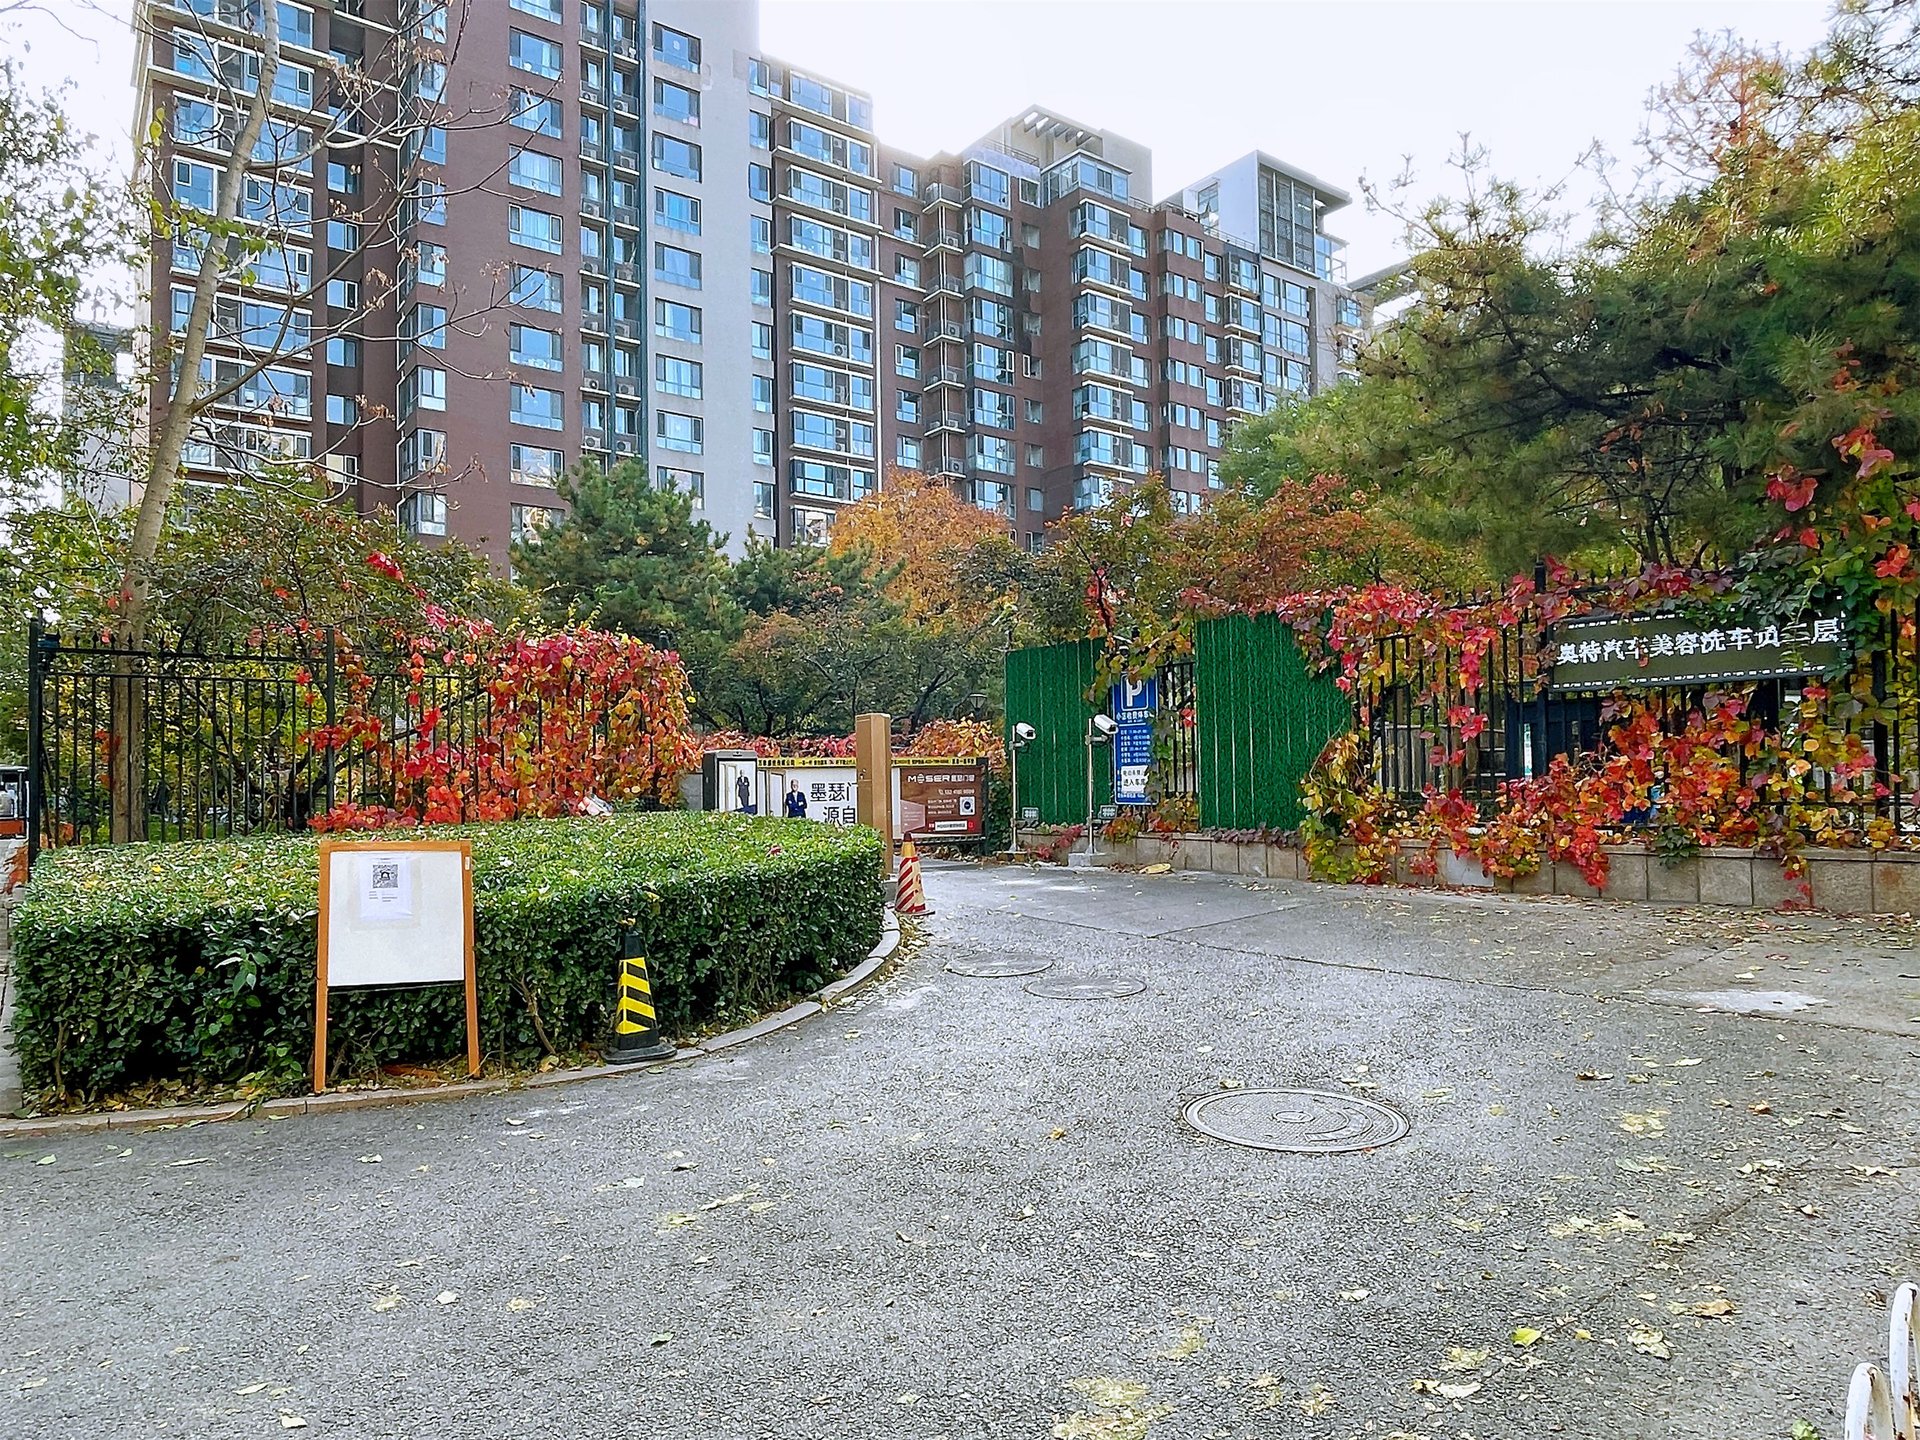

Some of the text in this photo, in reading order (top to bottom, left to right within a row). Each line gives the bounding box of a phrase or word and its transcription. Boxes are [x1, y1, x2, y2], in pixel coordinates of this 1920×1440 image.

[1126, 678, 1142, 707] P
[1116, 711, 1154, 720] 小区收费停车
